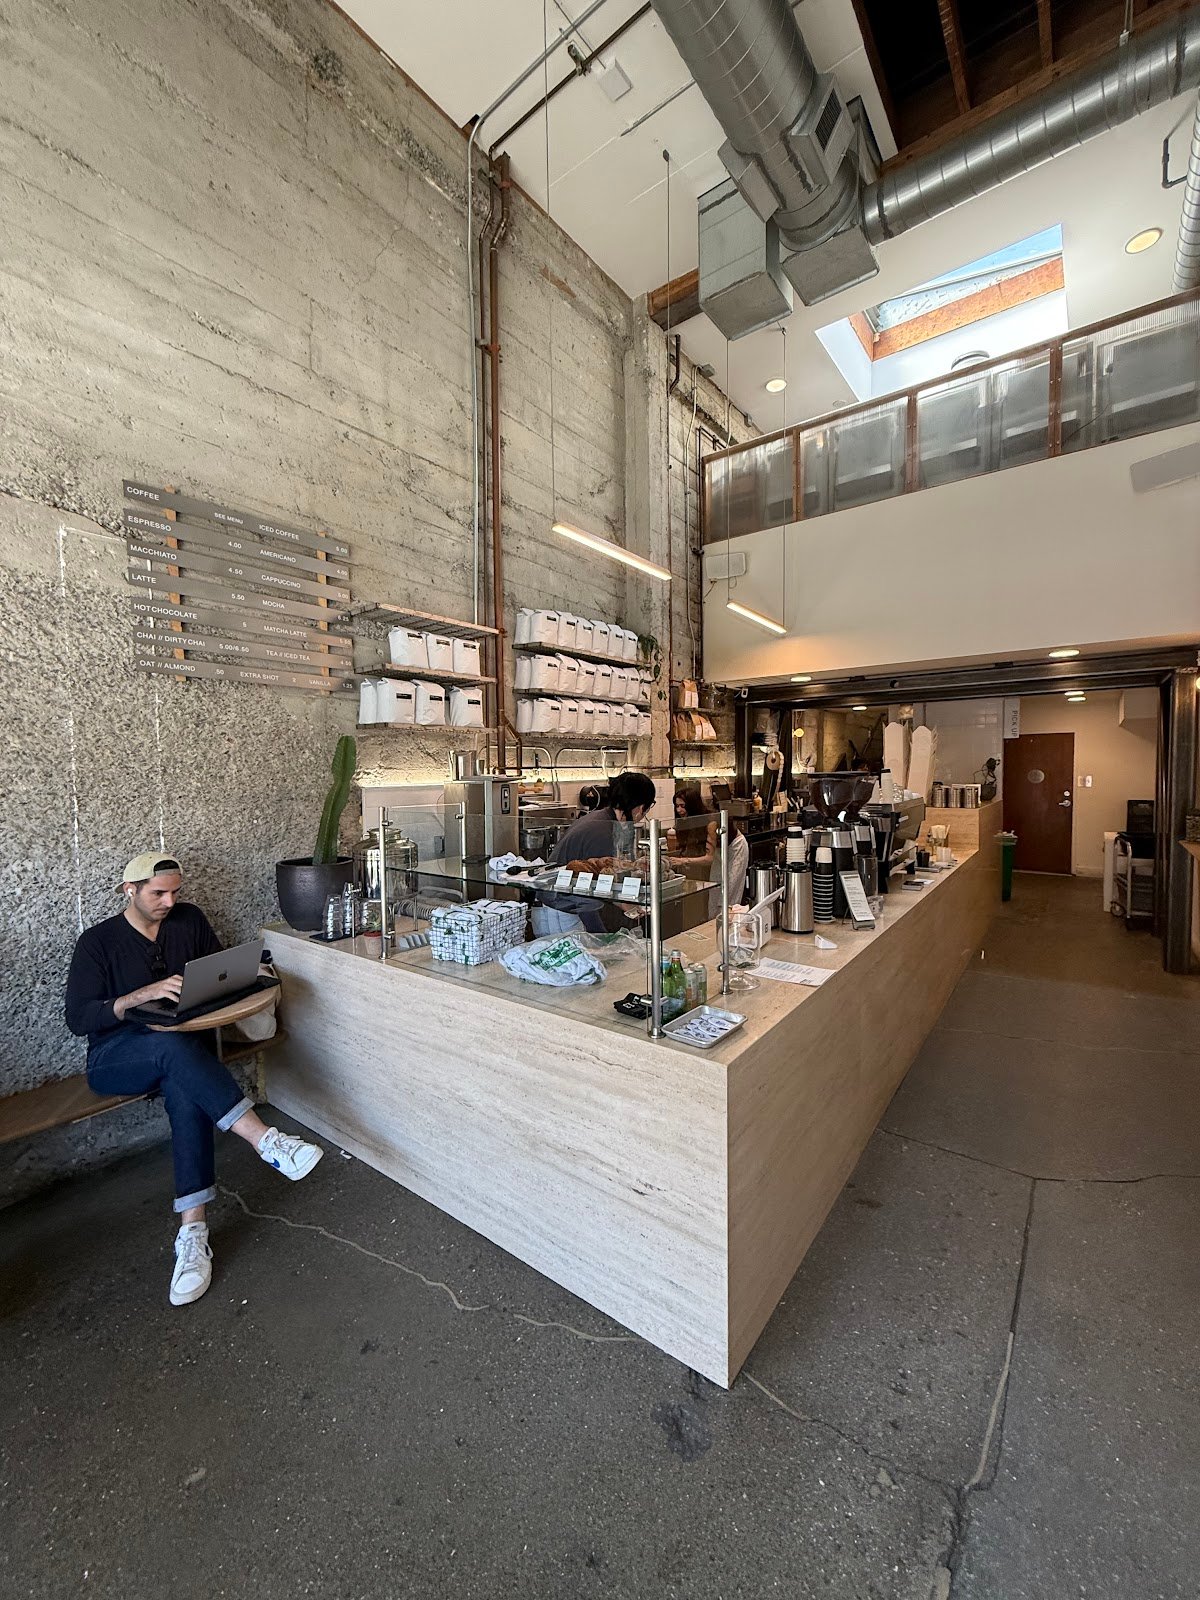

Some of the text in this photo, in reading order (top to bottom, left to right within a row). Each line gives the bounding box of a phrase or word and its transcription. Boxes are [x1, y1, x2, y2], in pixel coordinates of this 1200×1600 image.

[127, 486, 160, 501] COFFEE
[226, 515, 243, 524] MENU
[128, 515, 171, 532] ESPRESSO
[259, 524, 274, 533] ICED
[275, 529, 300, 540] COFFEE
[130, 544, 177, 560] MACCHIATO
[260, 549, 296, 563] AMERICANO
[131, 573, 156, 584] LATTE
[261, 575, 301, 589] CAPPUCCINO
[262, 600, 285, 609] MOCHA
[264, 625, 289, 635] MATCHA
[164, 663, 195, 672] ALMOND
[1011, 728, 1017, 737] UP
